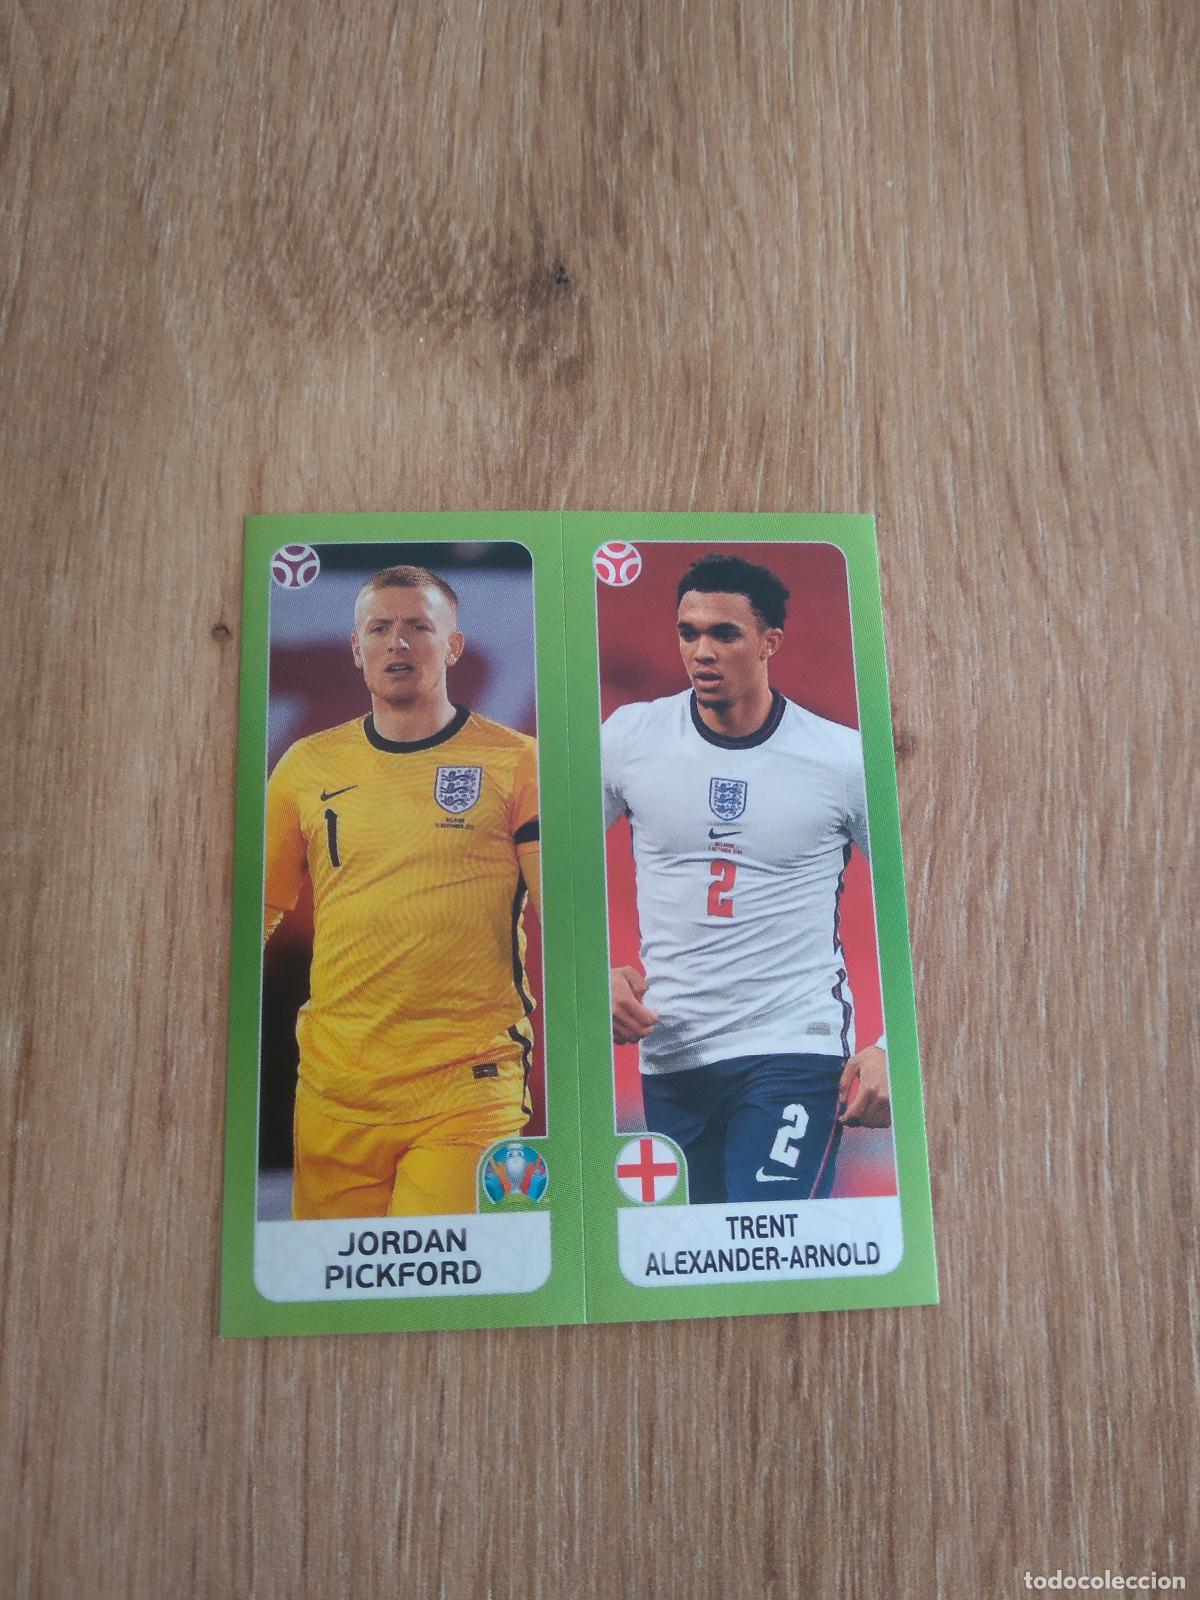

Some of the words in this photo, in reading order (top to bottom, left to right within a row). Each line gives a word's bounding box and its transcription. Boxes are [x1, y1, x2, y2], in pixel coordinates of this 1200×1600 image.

[324, 808, 340, 868] 1
[707, 858, 737, 918] 2
[769, 1103, 810, 1169] 2
[338, 1228, 467, 1256] JORDAN
[725, 1213, 799, 1240] TRENT
[325, 1260, 482, 1290] PICKFORD
[645, 1241, 881, 1276] ALEXANDER-ARNOLD
